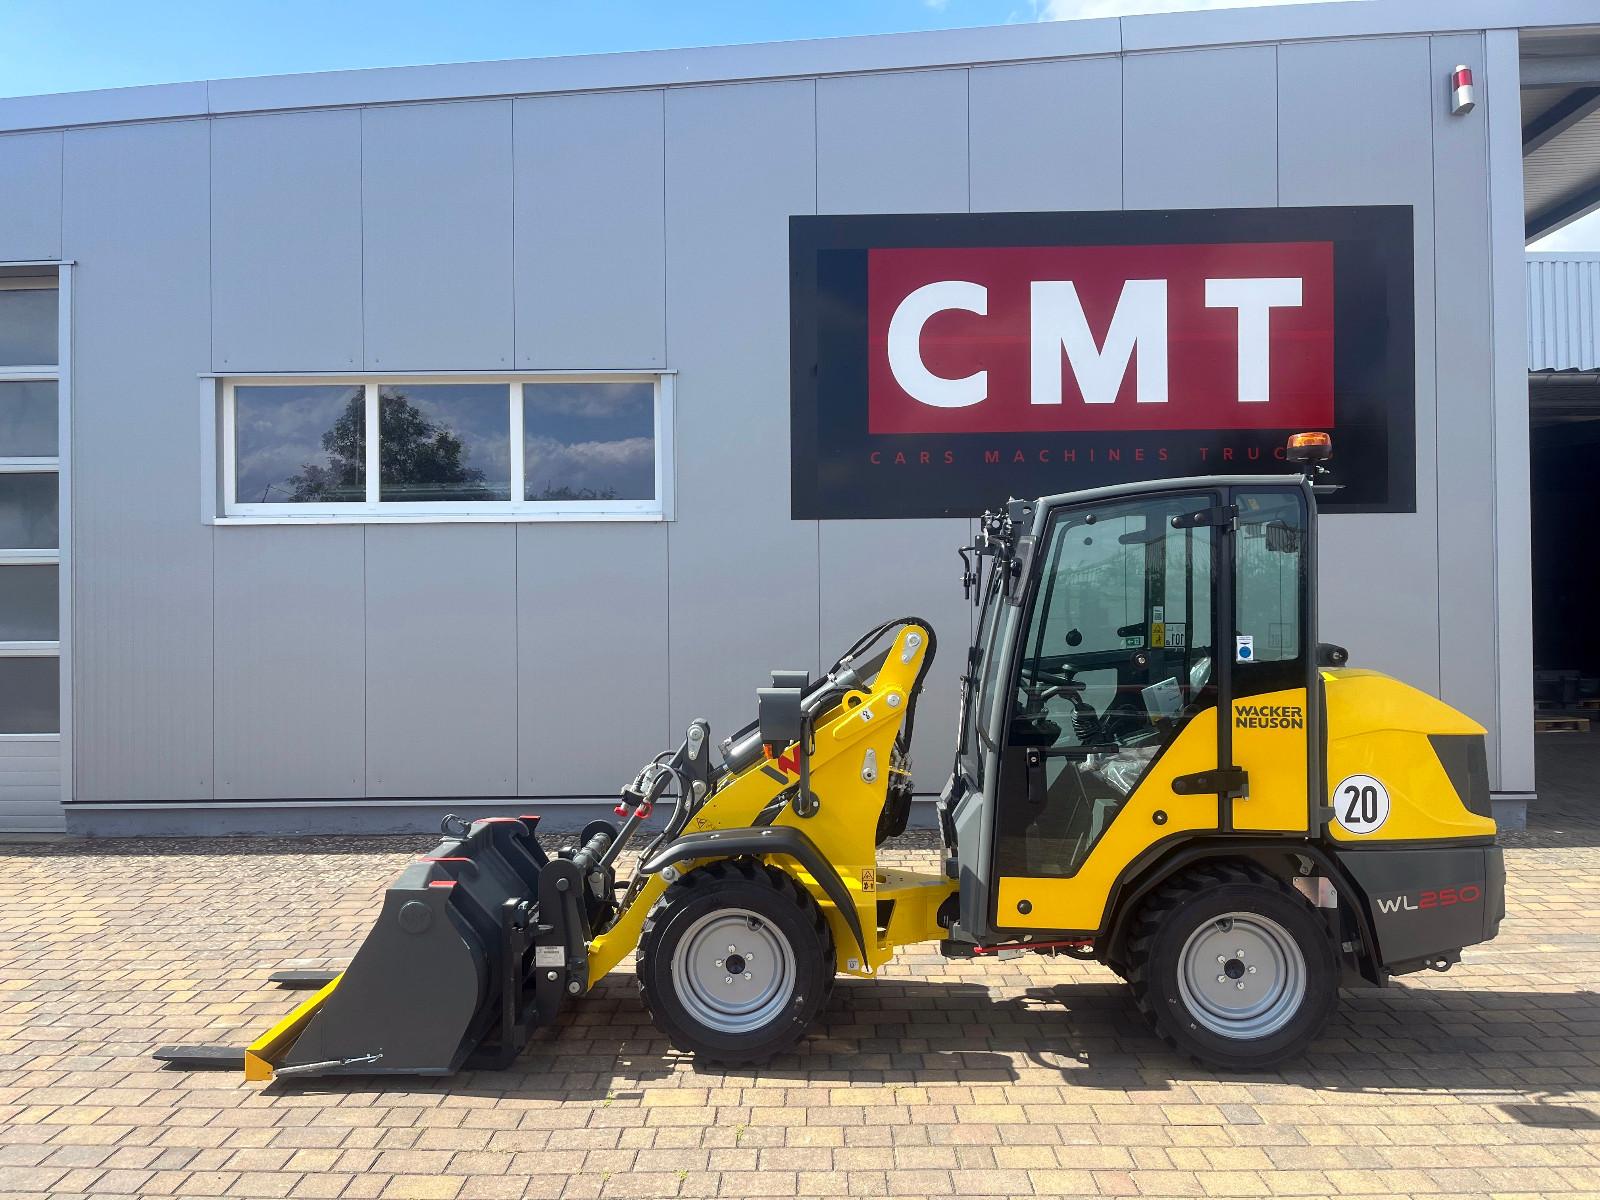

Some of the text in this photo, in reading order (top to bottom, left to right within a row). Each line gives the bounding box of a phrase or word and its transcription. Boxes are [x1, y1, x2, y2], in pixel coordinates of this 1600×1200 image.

[887, 277, 1303, 408] CMT
[870, 447, 1334, 465] CARS MACHINES TRUC
[1235, 706, 1302, 717] WACKER
[1235, 717, 1303, 728] NEUSON
[1343, 785, 1378, 824] 20
[1376, 885, 1482, 914] WL250
